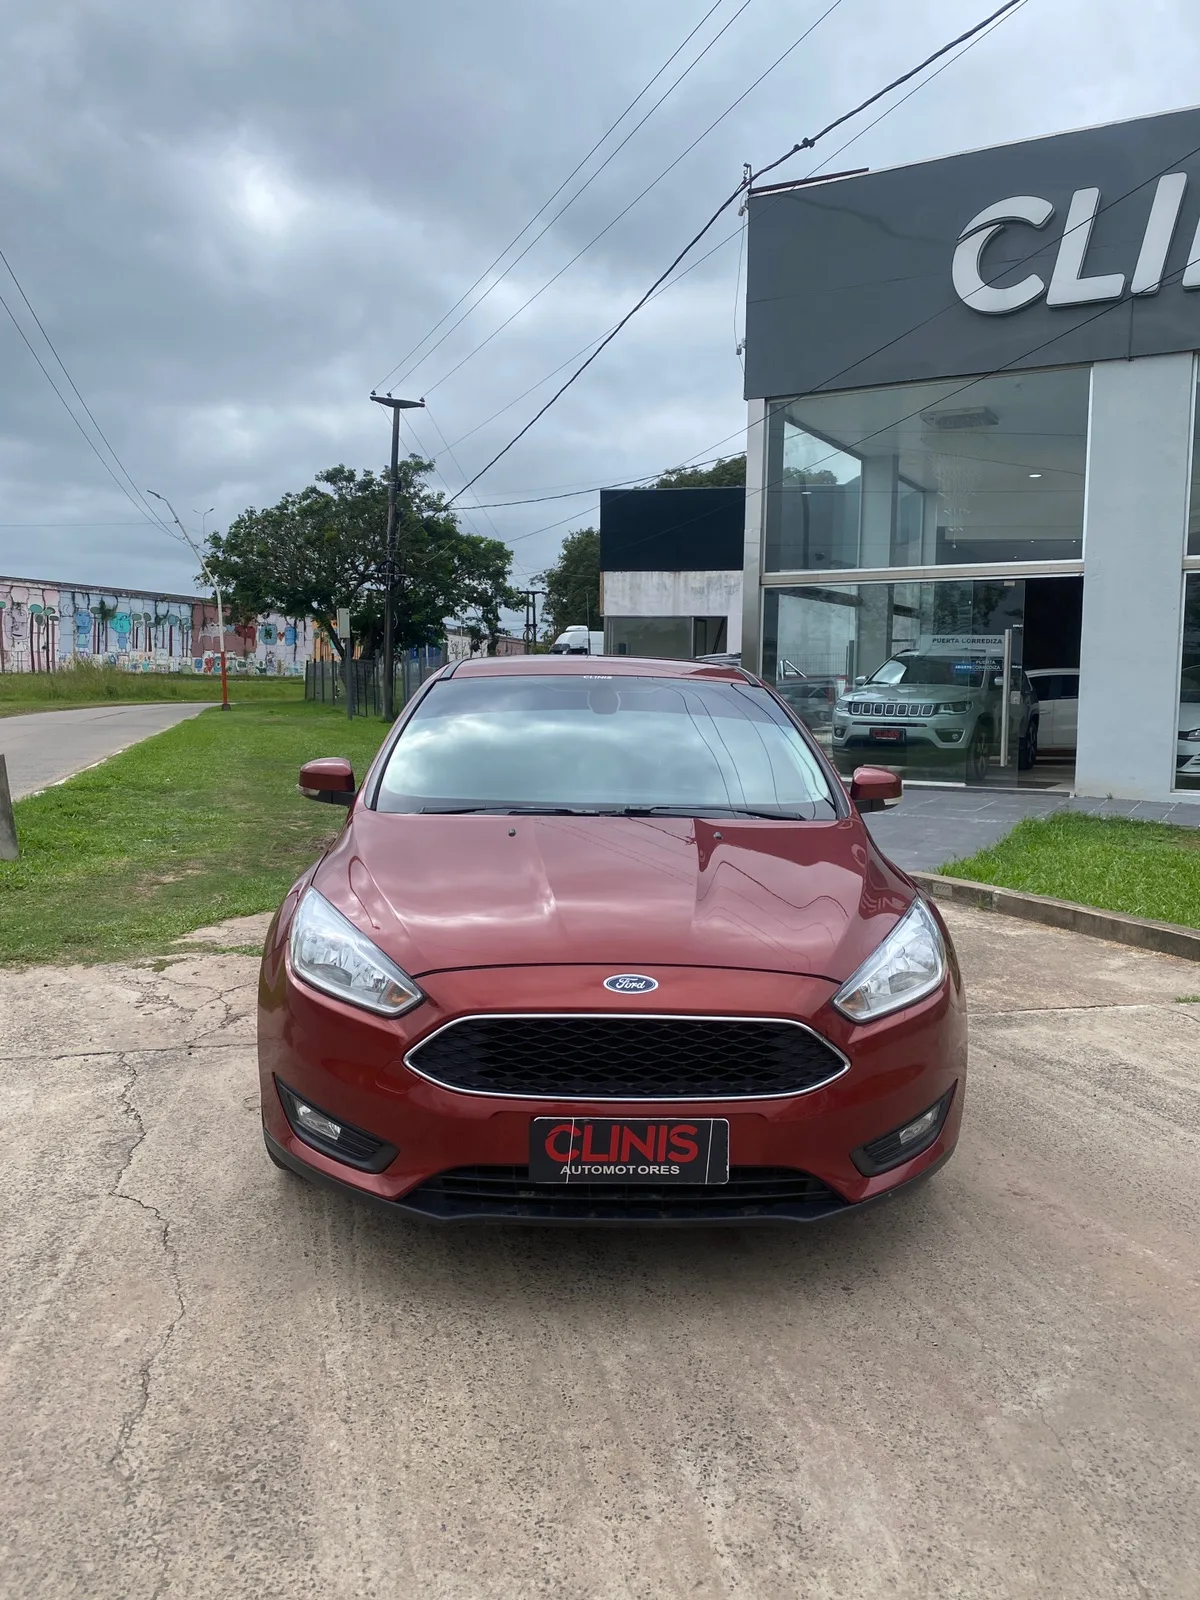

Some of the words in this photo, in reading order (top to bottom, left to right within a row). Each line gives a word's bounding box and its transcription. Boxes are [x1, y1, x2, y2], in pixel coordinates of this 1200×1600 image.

[952, 171, 1200, 315] CLI
[615, 977, 646, 989] Ford
[544, 1124, 699, 1163] CLINIS
[560, 1165, 680, 1175] AUTOMOTORES
